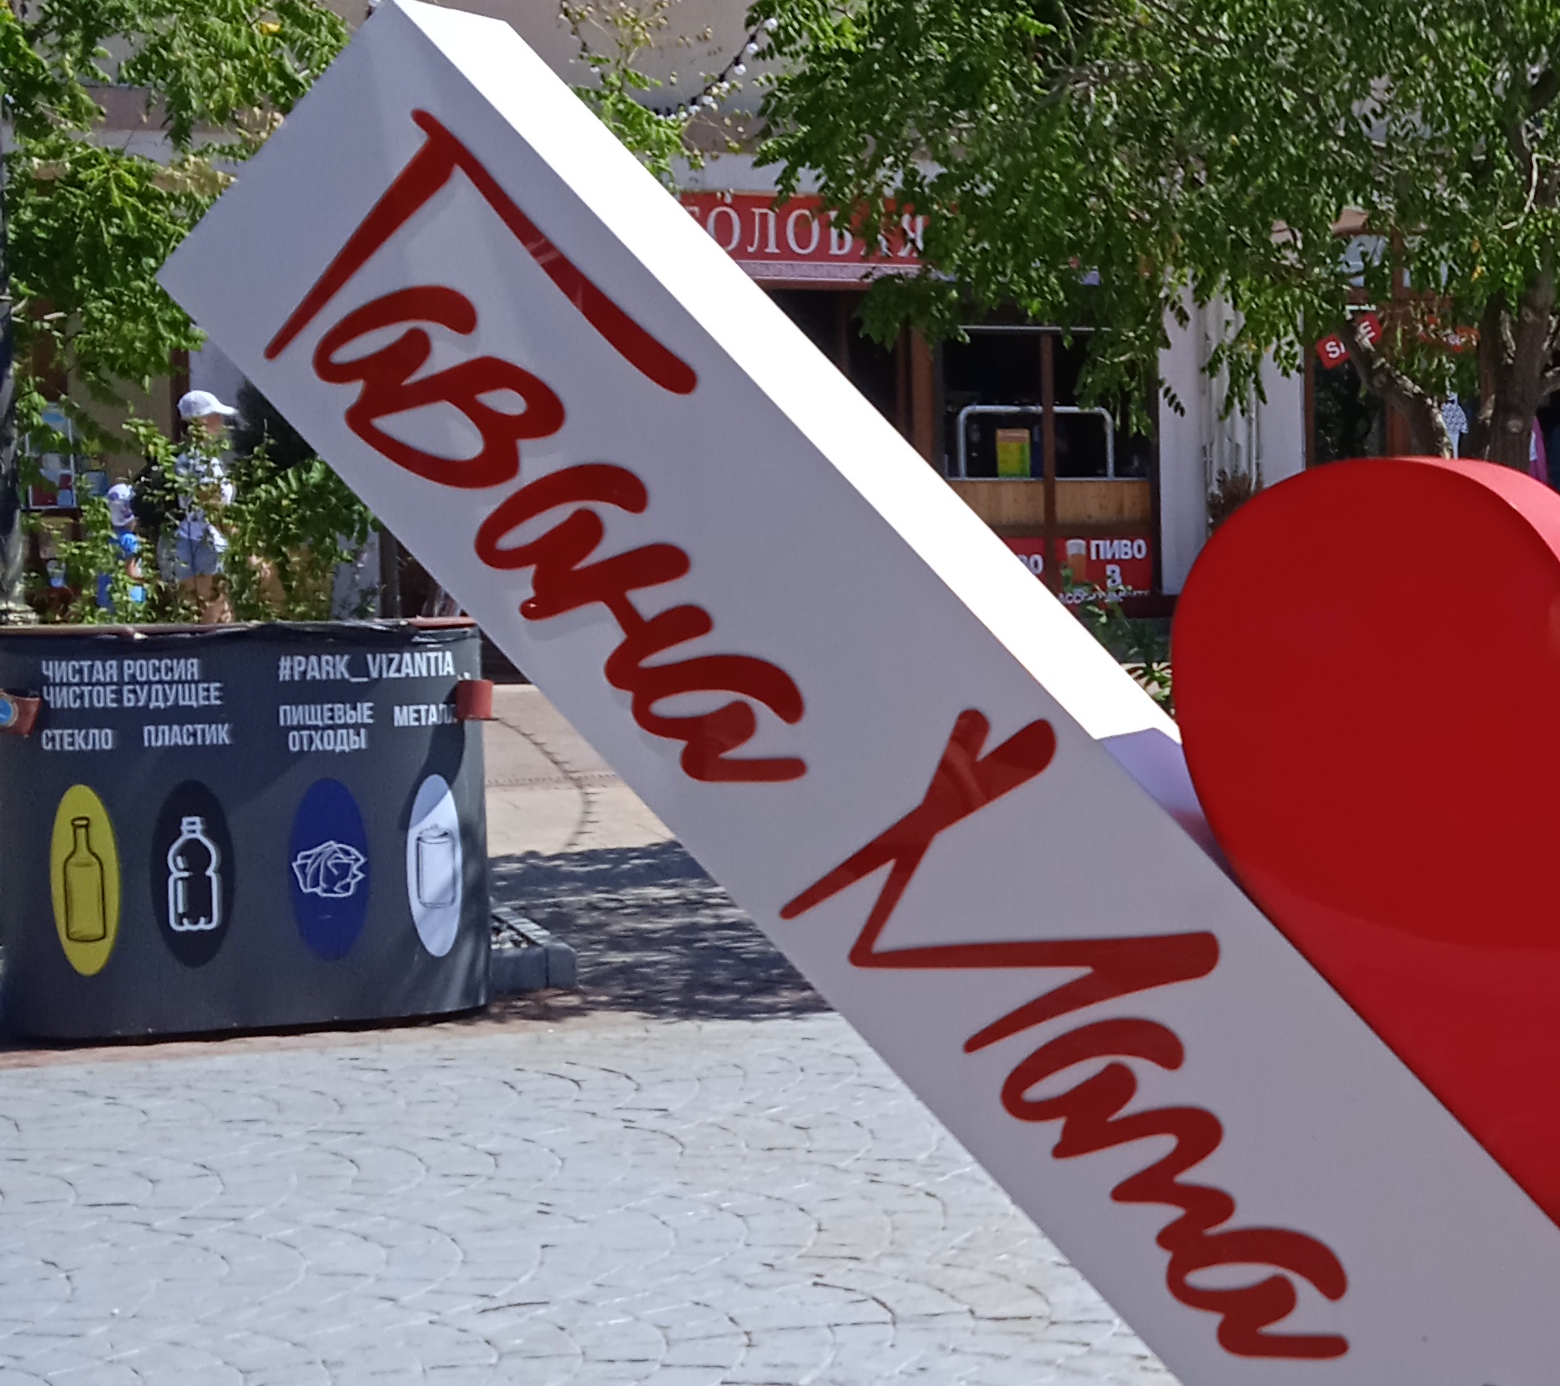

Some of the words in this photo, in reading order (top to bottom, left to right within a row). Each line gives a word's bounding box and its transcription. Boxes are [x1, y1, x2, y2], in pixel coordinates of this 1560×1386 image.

[1090, 539, 1147, 560] ПИВО
[42, 660, 118, 683] ЧИСТАЯ
[123, 658, 200, 682] РОССИЯ
[279, 651, 456, 682] #PARK_VIZANTIA
[42, 685, 118, 708] ЧИСТОЕ
[123, 683, 223, 709] БУДУЩЕЕ
[279, 702, 374, 727] ПИЩЕВЫЕ
[41, 728, 114, 751] СТЕКЛО
[143, 723, 231, 747] ПЛАСТИК
[264, 108, 806, 782] Гавана
[779, 708, 1350, 1360] Мама
[288, 728, 368, 753] ОТХОДЫ
